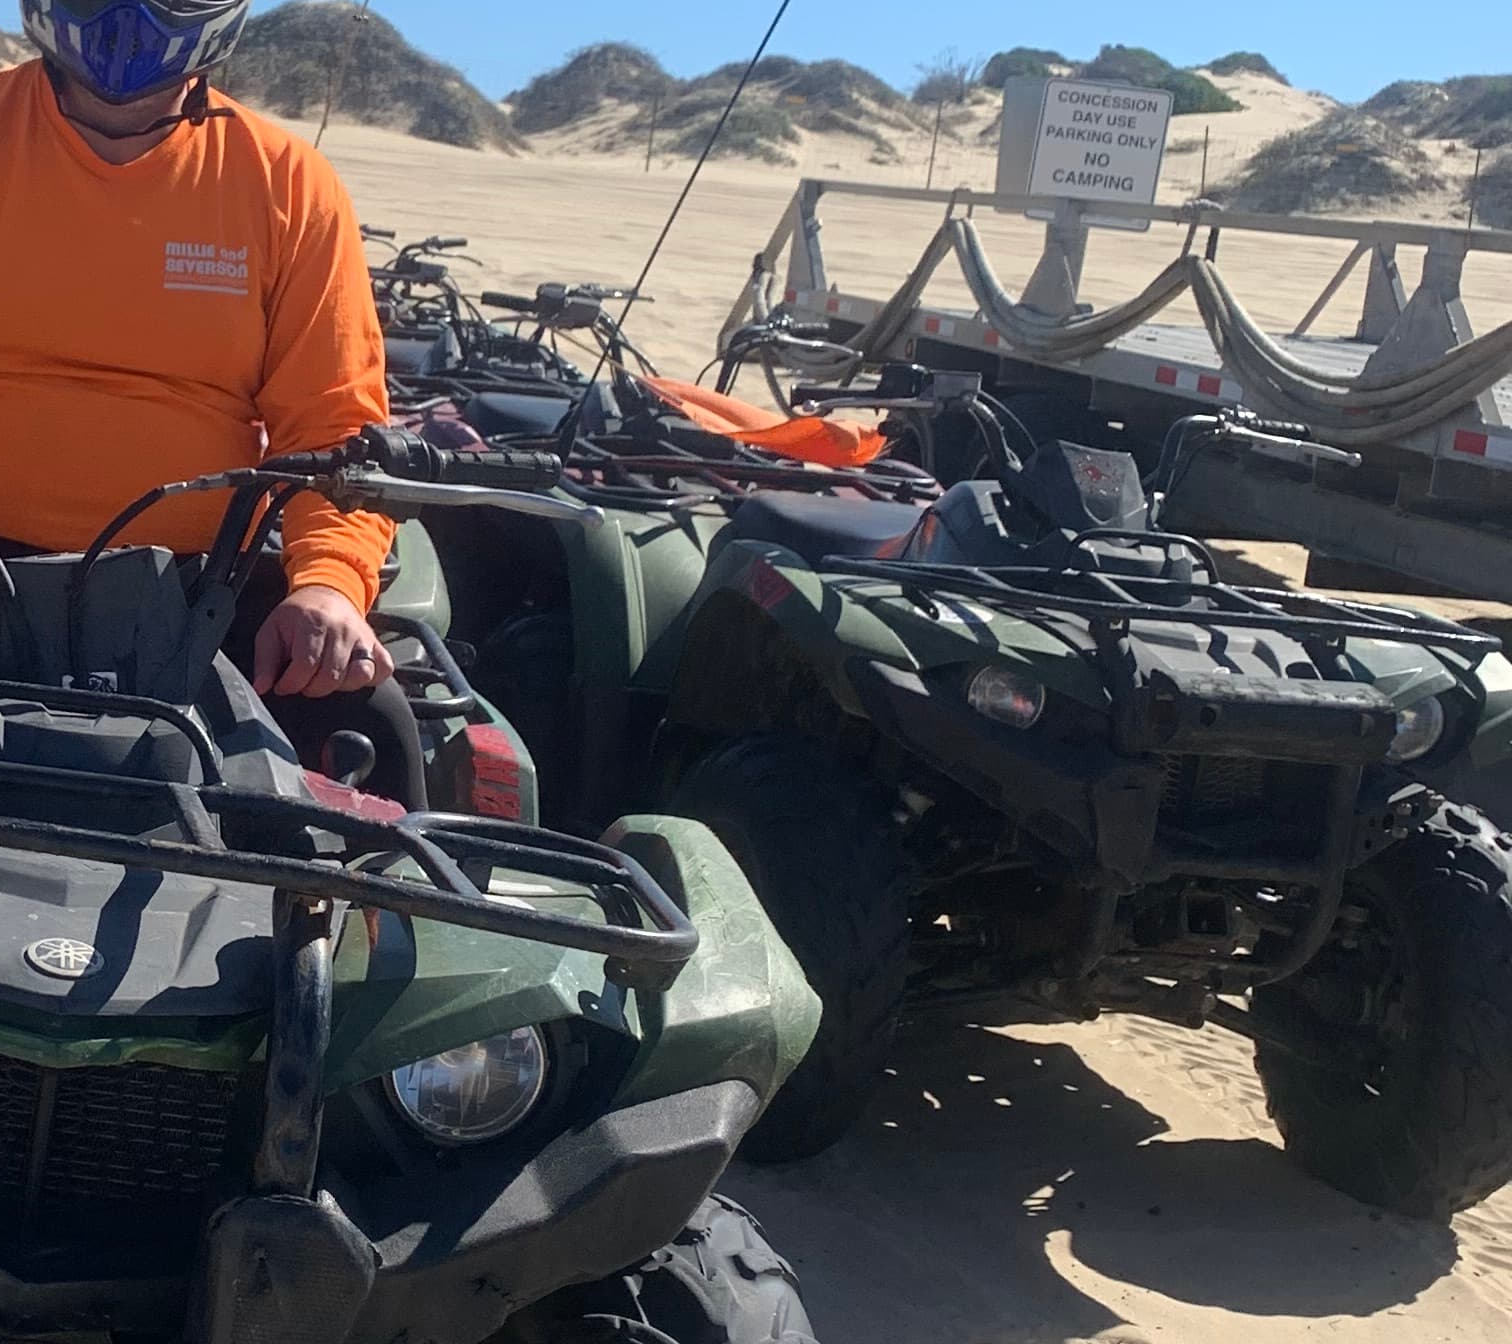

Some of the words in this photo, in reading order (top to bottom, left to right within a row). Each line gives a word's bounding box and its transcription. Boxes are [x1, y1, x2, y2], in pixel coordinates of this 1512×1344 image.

[1058, 90, 1158, 113] CONCESSION
[1072, 110, 1103, 124] DAY
[1106, 114, 1137, 129] USE
[1045, 125, 1113, 145] PARKING
[1117, 135, 1158, 150] ONLY
[1083, 152, 1111, 168] NO
[1052, 169, 1135, 192] CAMPING
